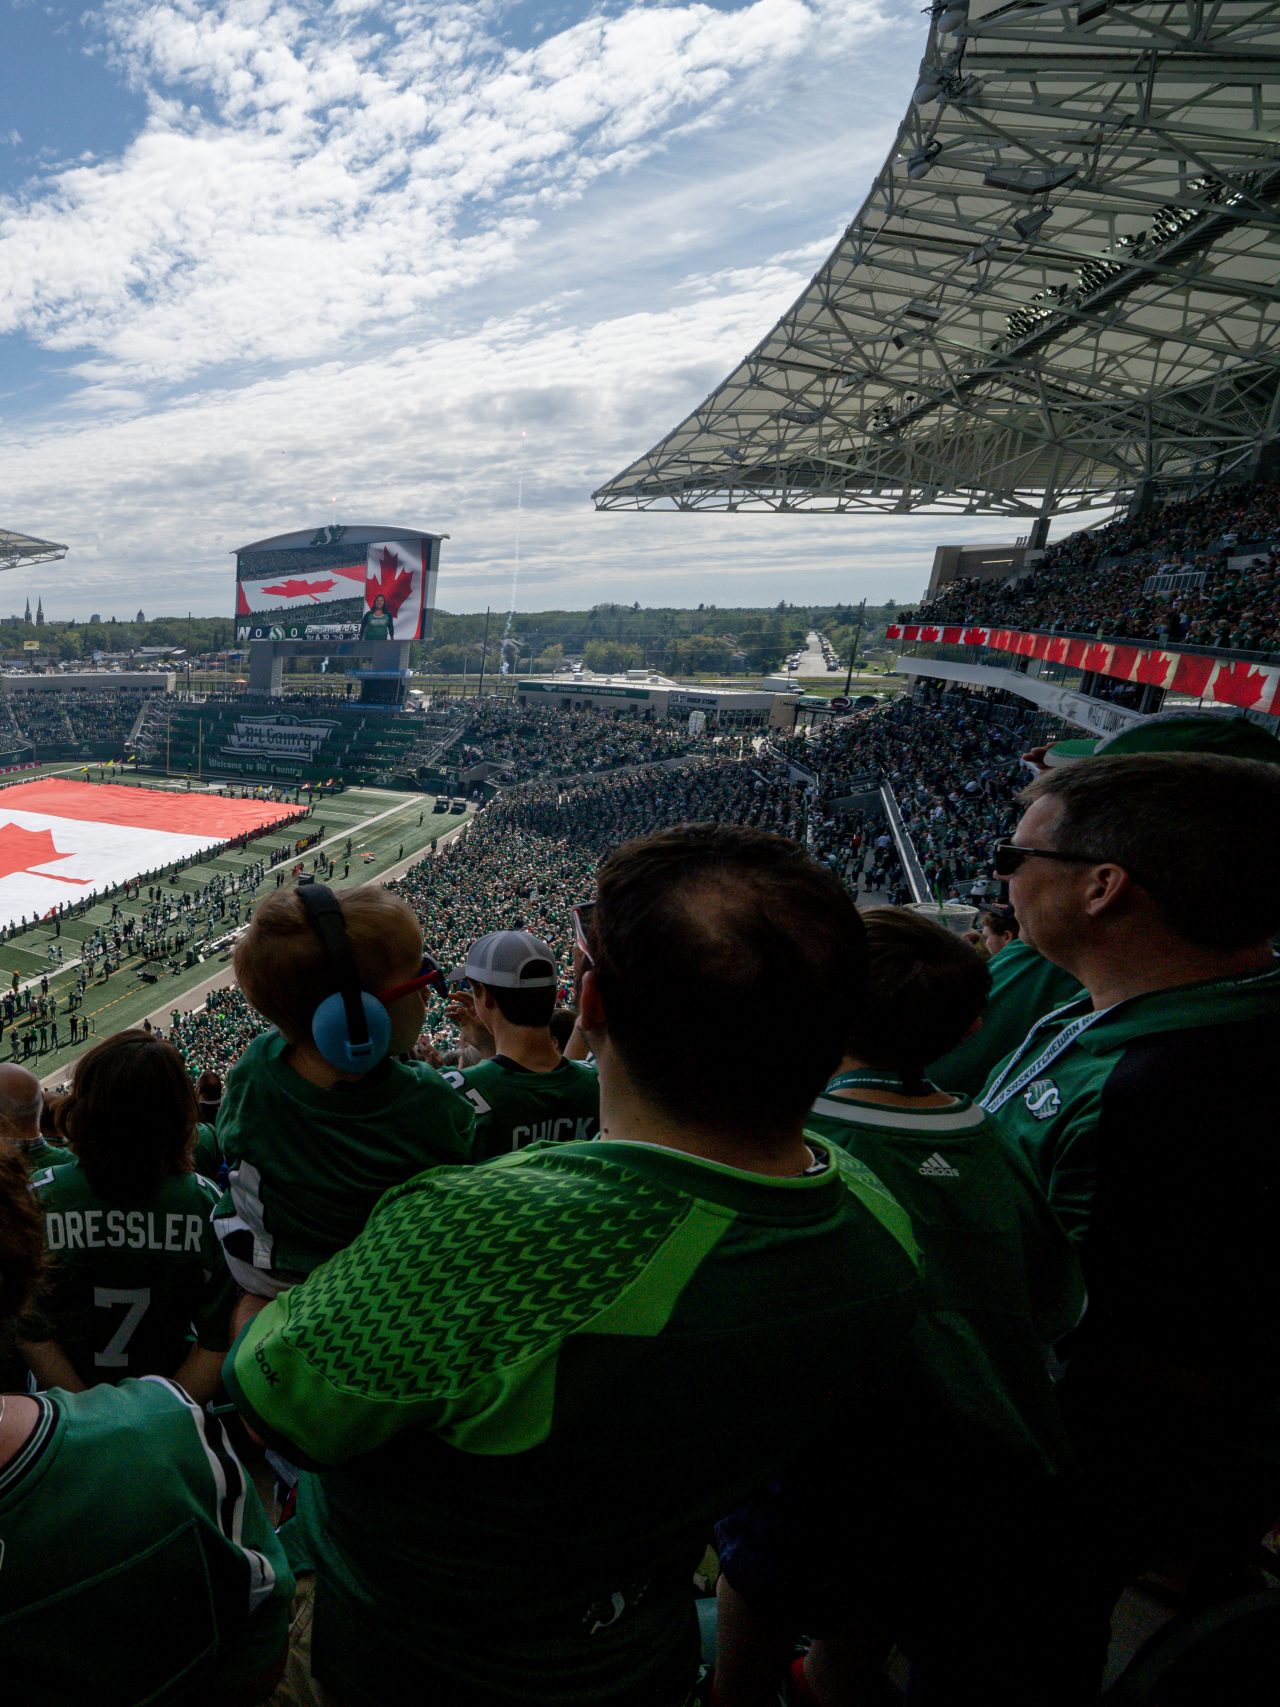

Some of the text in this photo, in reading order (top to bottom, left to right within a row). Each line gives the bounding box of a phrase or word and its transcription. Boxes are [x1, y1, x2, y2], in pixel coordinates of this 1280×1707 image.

[255, 629, 262, 638] 0
[290, 627, 298, 638] 0
[209, 759, 243, 769] Welcome
[919, 1167, 960, 1177] adidas
[46, 1209, 204, 1253] DRESSLER
[93, 1286, 152, 1368] 7
[254, 1328, 282, 1389] bok
